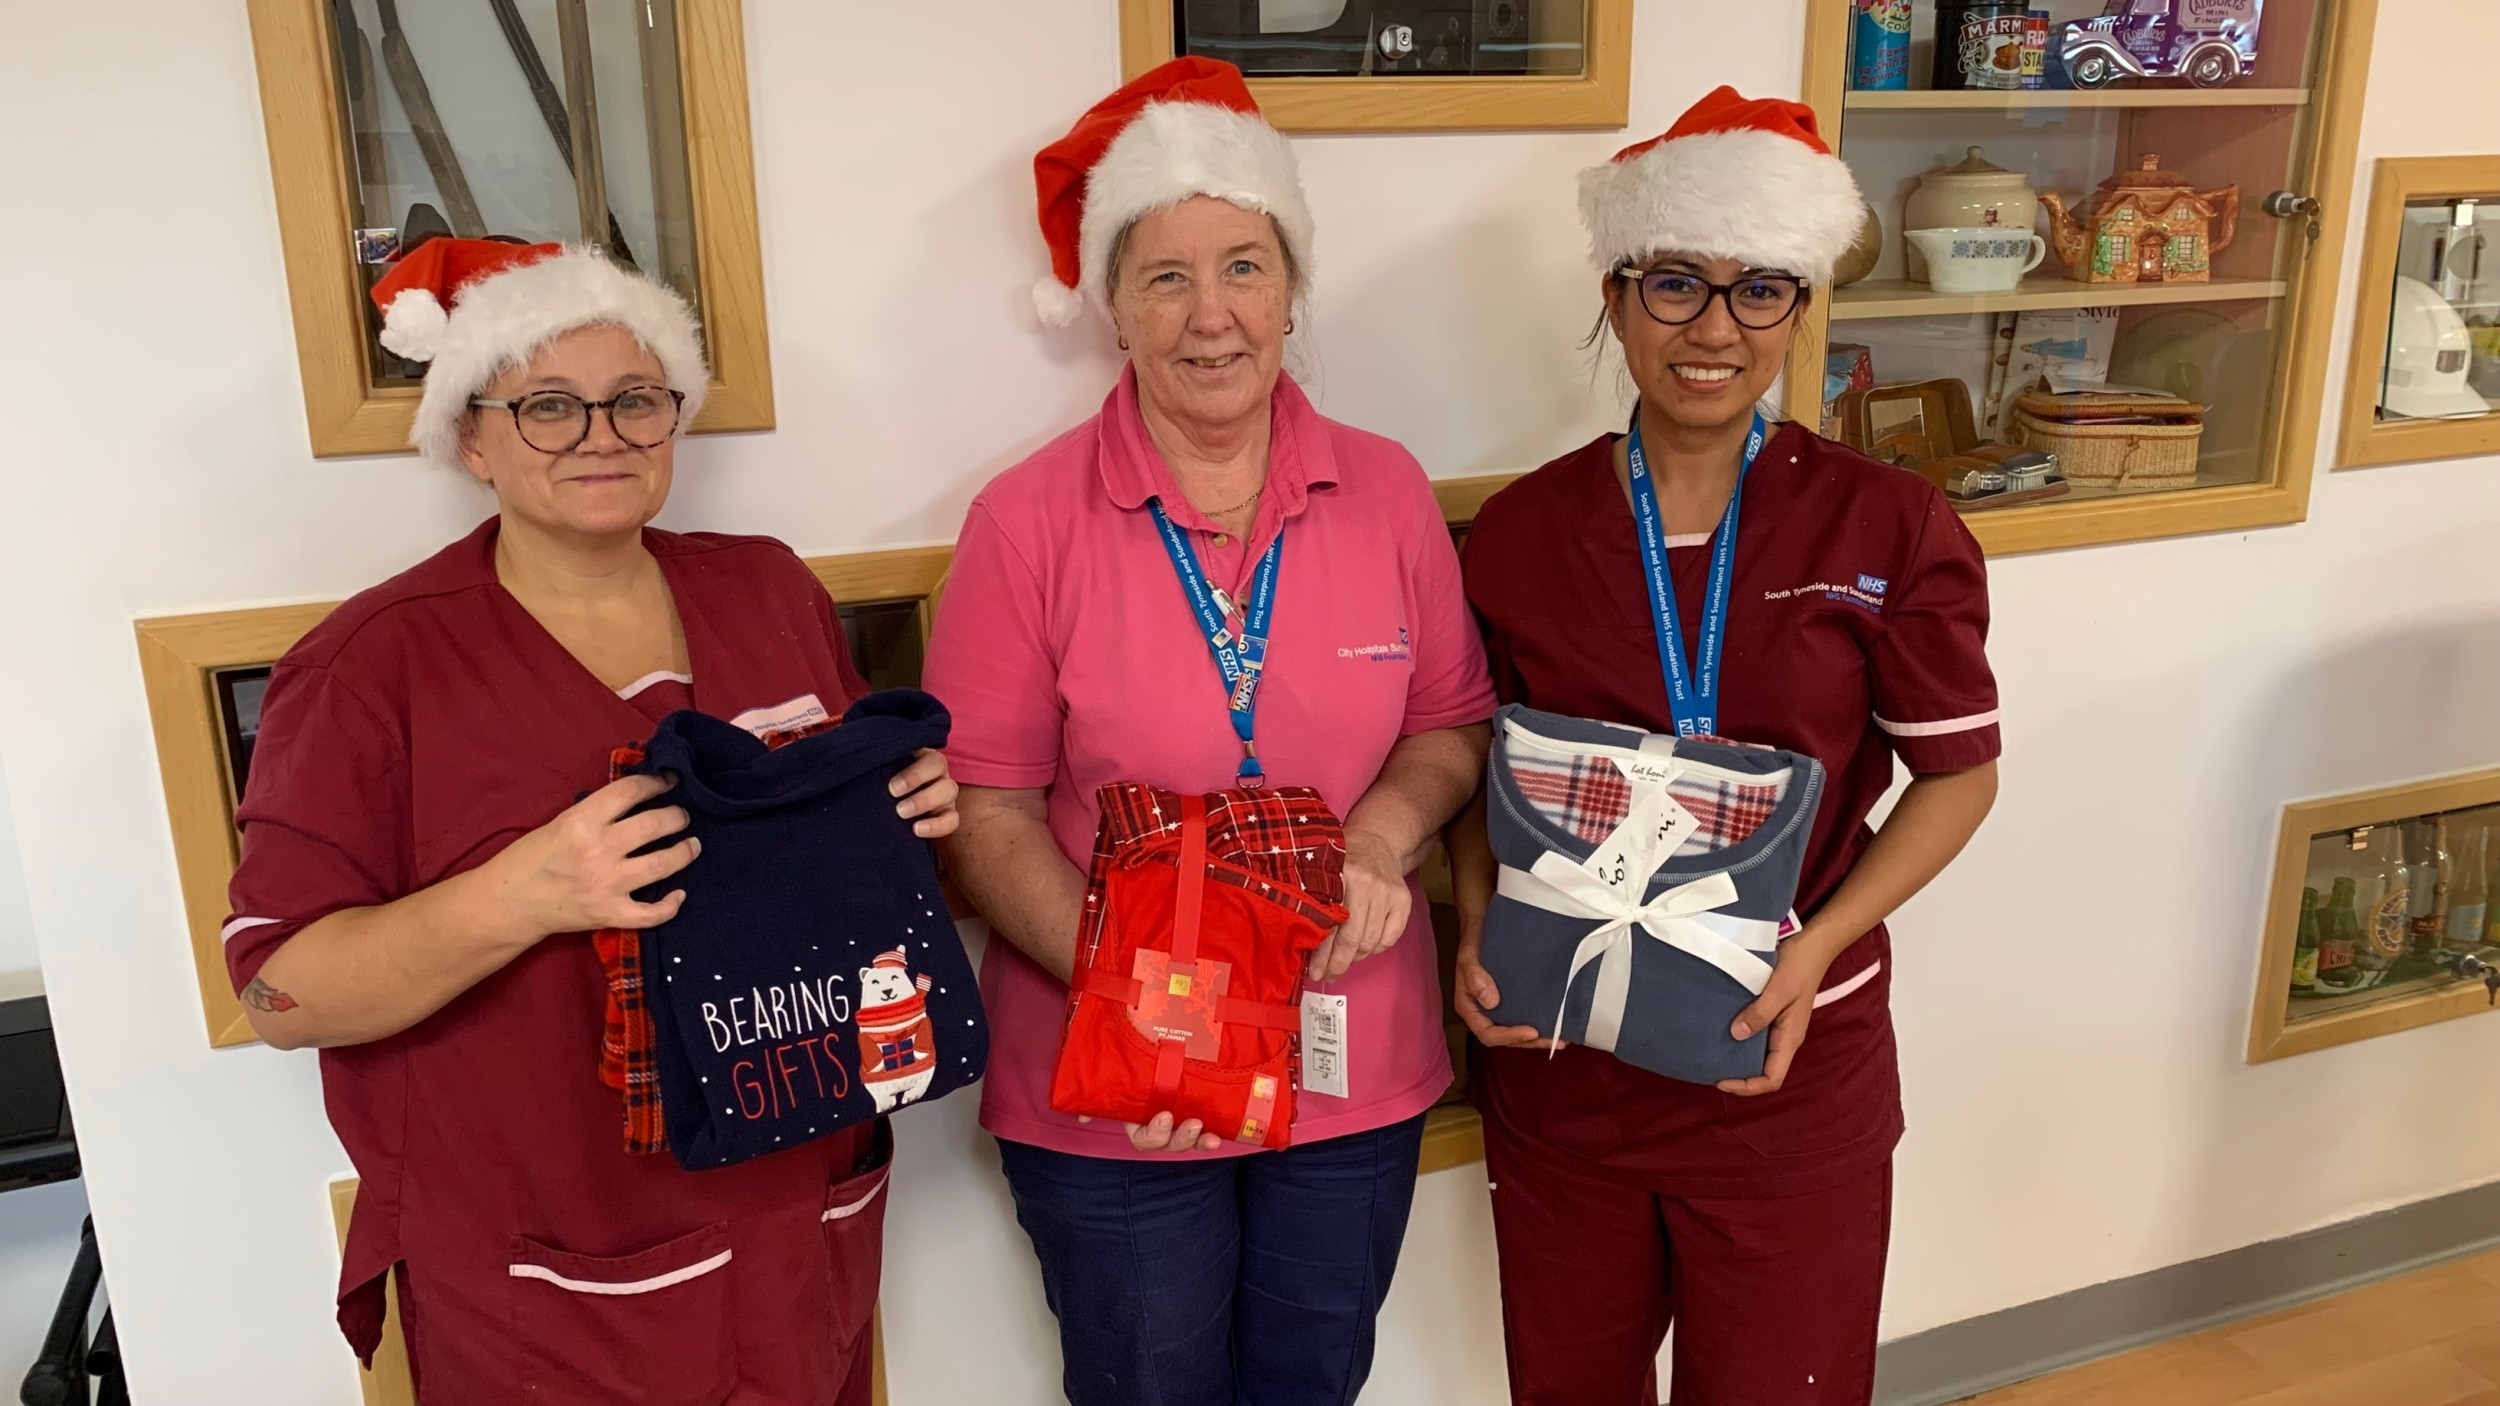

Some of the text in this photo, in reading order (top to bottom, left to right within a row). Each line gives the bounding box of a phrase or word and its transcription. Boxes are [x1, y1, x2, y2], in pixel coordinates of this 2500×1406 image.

[2123, 28, 2166, 46] CADBURYS
[1748, 434, 1761, 460] NHS
[1632, 451, 1644, 477] NHS
[1161, 514, 1186, 559] Sunderland
[1180, 557, 1194, 574] and
[1266, 545, 1275, 563] NHS
[1718, 546, 1728, 565] NHS
[1189, 575, 1208, 609] Tyneside
[1256, 563, 1273, 608] Foundation
[1641, 492, 1684, 701] South Tyneside and Sunderland NHS Foundation Trust
[1711, 566, 1725, 614] Sunderland
[1764, 581, 1884, 606] South Tyneside and Sunderland
[1825, 591, 1841, 600] NHS
[1857, 575, 1887, 593] NHS
[1203, 609, 1219, 633] South
[1253, 608, 1265, 629] Trust
[1709, 615, 1718, 632] and
[1337, 647, 1354, 659] City
[1354, 644, 1389, 657] Hospitals
[1704, 634, 1716, 670] Tyneside
[1219, 650, 1239, 681] NHS
[1236, 678, 1258, 712] NHS
[1702, 673, 1712, 698] South
[1631, 764, 1644, 774] hot
[701, 975, 849, 1053] BEARING
[1153, 1026, 1193, 1037] PURE COTTON
[1158, 1033, 1185, 1042] PYJAMAS
[732, 1033, 849, 1120] GIFTS
